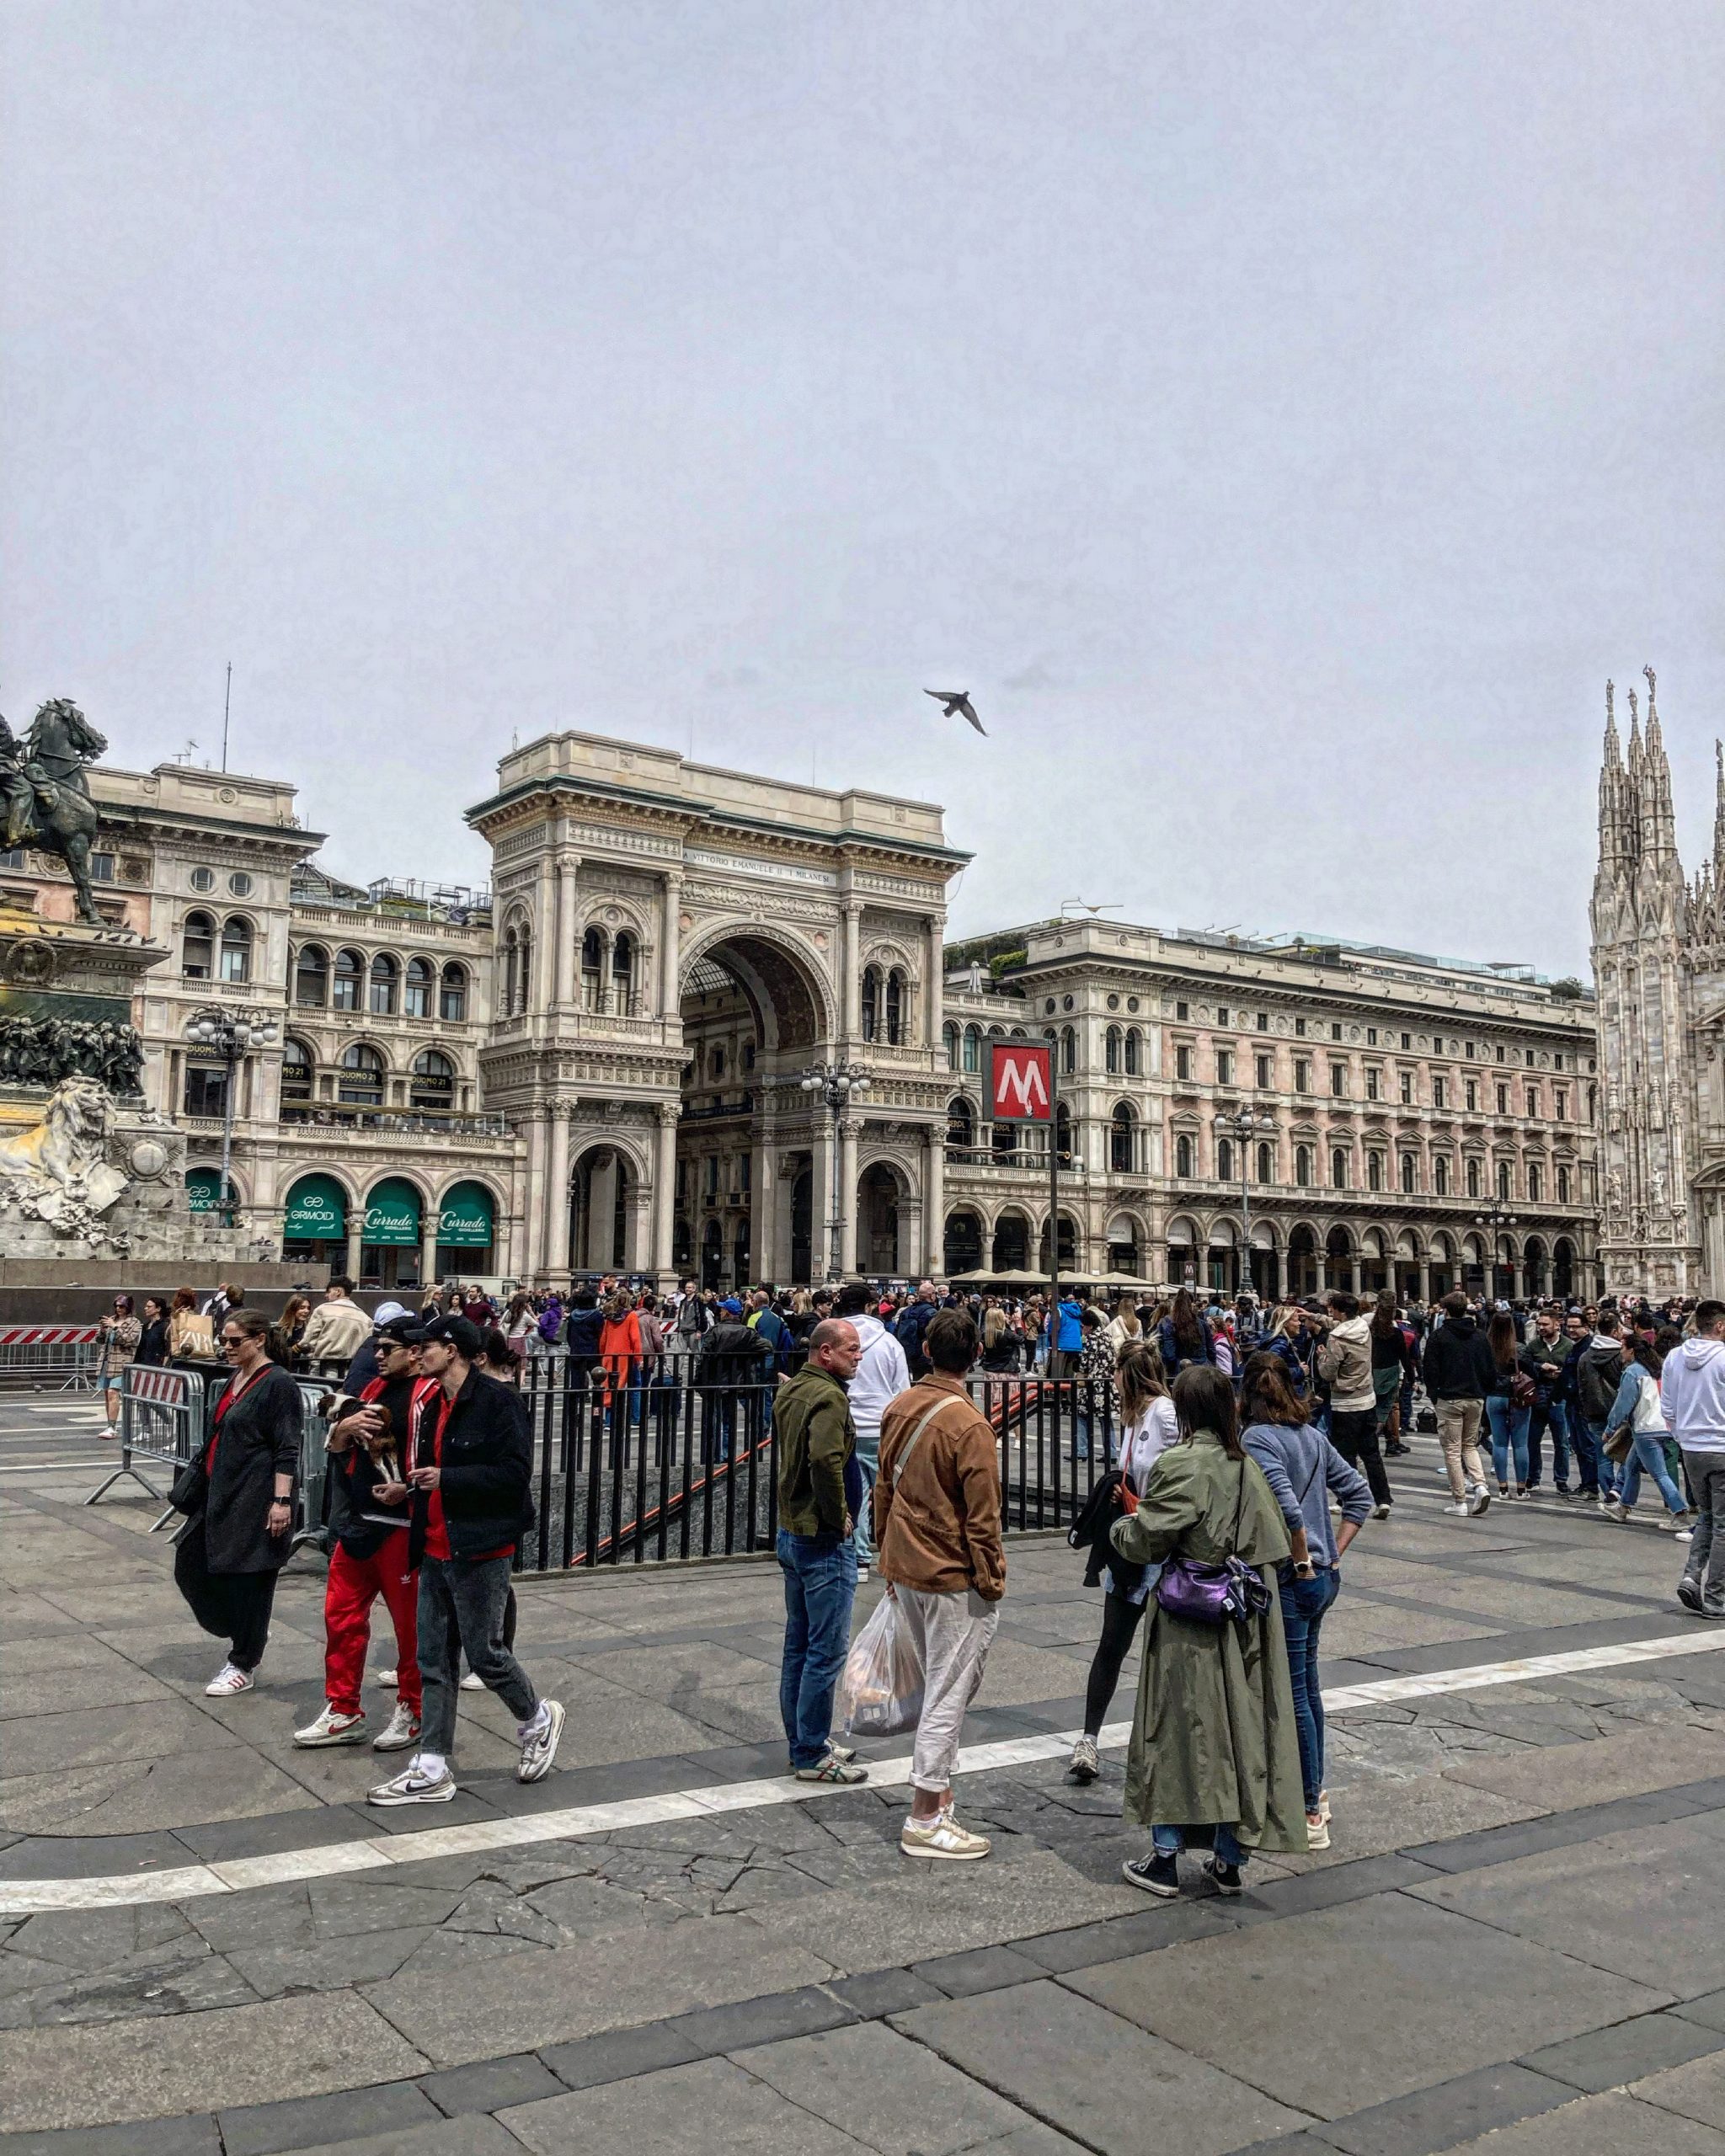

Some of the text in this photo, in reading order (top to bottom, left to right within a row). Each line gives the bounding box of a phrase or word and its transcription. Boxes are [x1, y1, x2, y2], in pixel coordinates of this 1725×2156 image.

[693, 853, 729, 866] VITTORIO
[732, 860, 773, 874] EMANUELE
[796, 870, 829, 883] MILANESI
[340, 1071, 367, 1080] DUOMO
[996, 1059, 1048, 1105] M
[291, 1210, 334, 1220] GRIMOLDI
[364, 1208, 413, 1230] Currado
[440, 1211, 486, 1231] Currado
[1185, 1264, 1194, 1274] M
